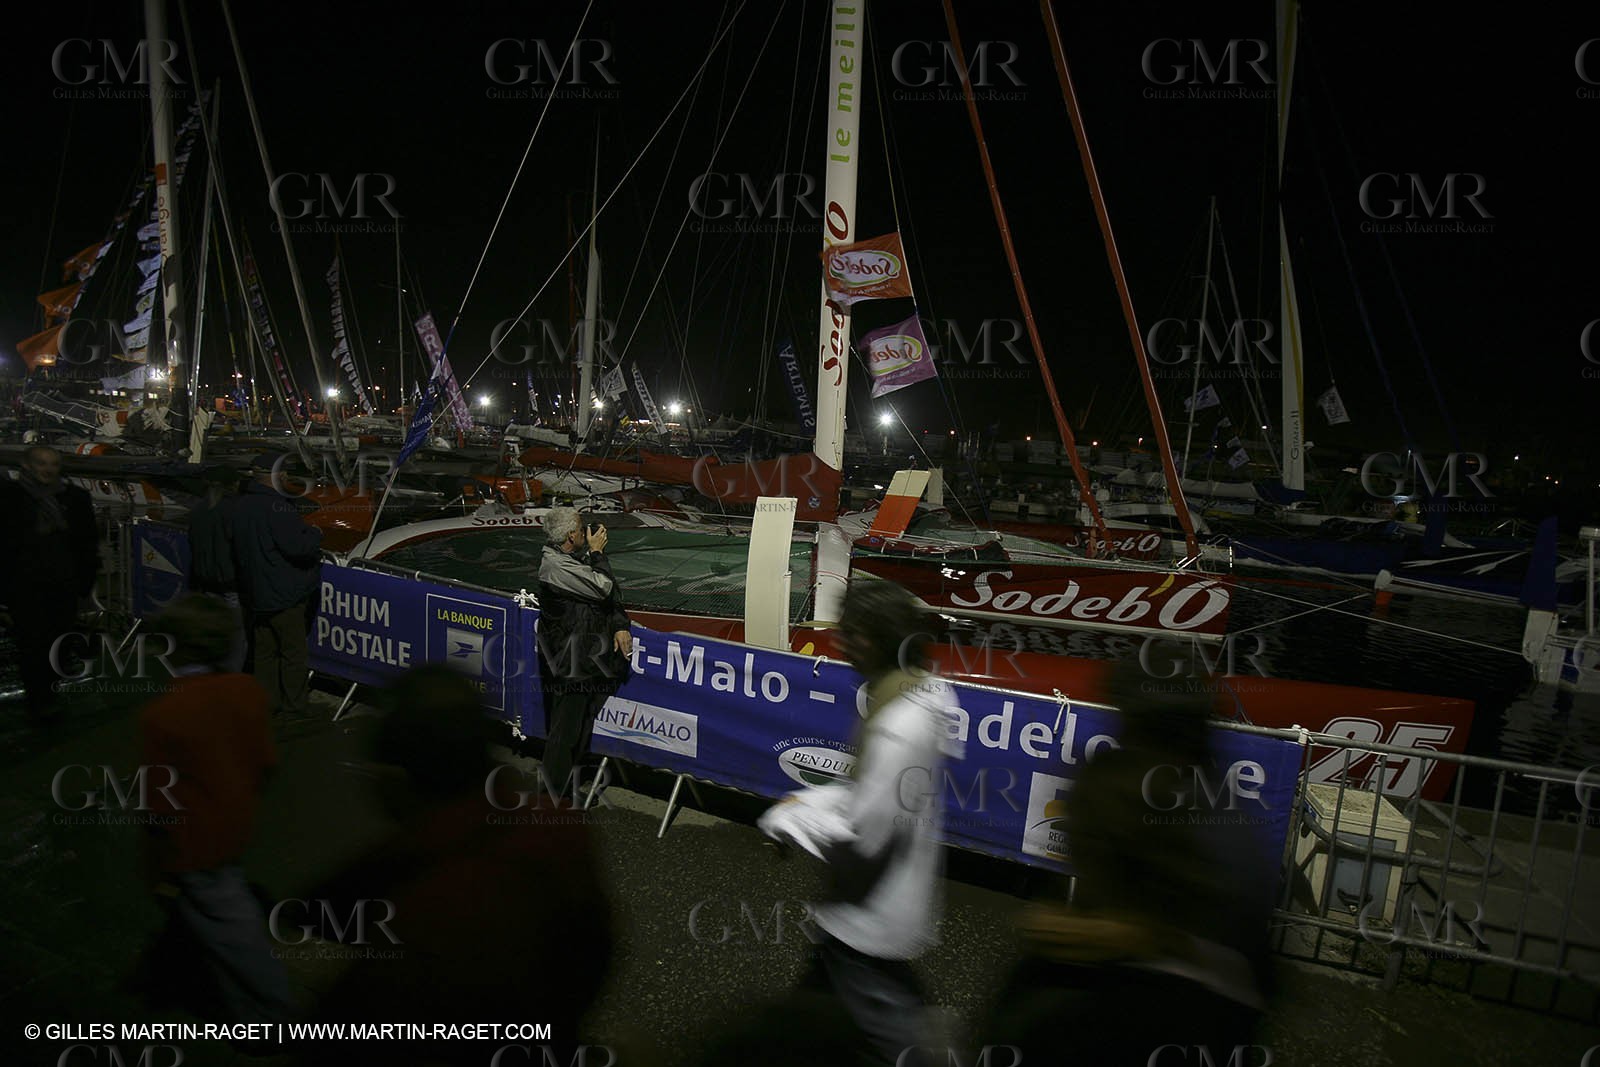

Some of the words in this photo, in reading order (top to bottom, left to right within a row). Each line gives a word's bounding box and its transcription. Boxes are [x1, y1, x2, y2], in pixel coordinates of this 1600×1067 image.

[320, 581, 391, 627] RHUM
[437, 608, 450, 621] LA
[451, 611, 493, 631] BANQUE
[950, 570, 1230, 630] Sodeb'O
[316, 616, 412, 669] POSTALE
[635, 714, 691, 742] MALO
[792, 751, 820, 766] PEN
[1299, 716, 1455, 800] 25
